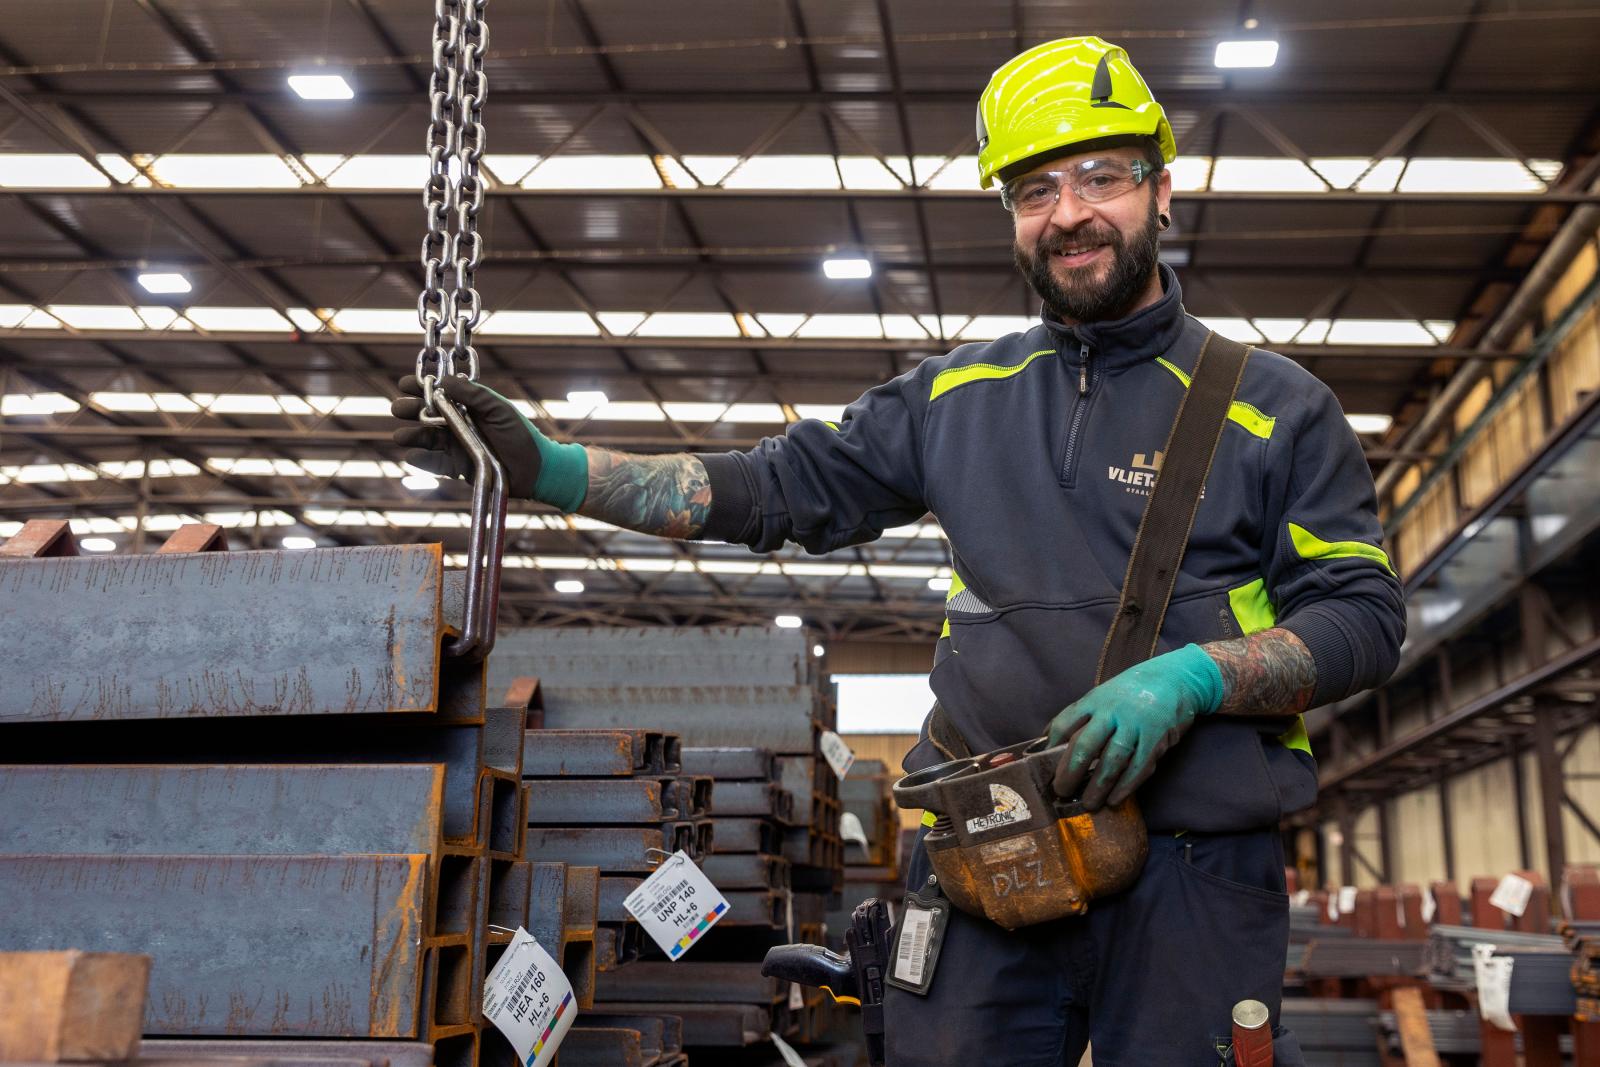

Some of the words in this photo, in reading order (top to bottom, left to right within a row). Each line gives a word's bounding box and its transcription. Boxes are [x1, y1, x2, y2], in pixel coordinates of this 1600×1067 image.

[657, 901, 678, 922] UNP
[679, 886, 696, 903] 140
[673, 902, 698, 927] HL+6
[513, 995, 533, 1023] HEA
[530, 971, 546, 993] 160
[528, 992, 550, 1026] HL+6
